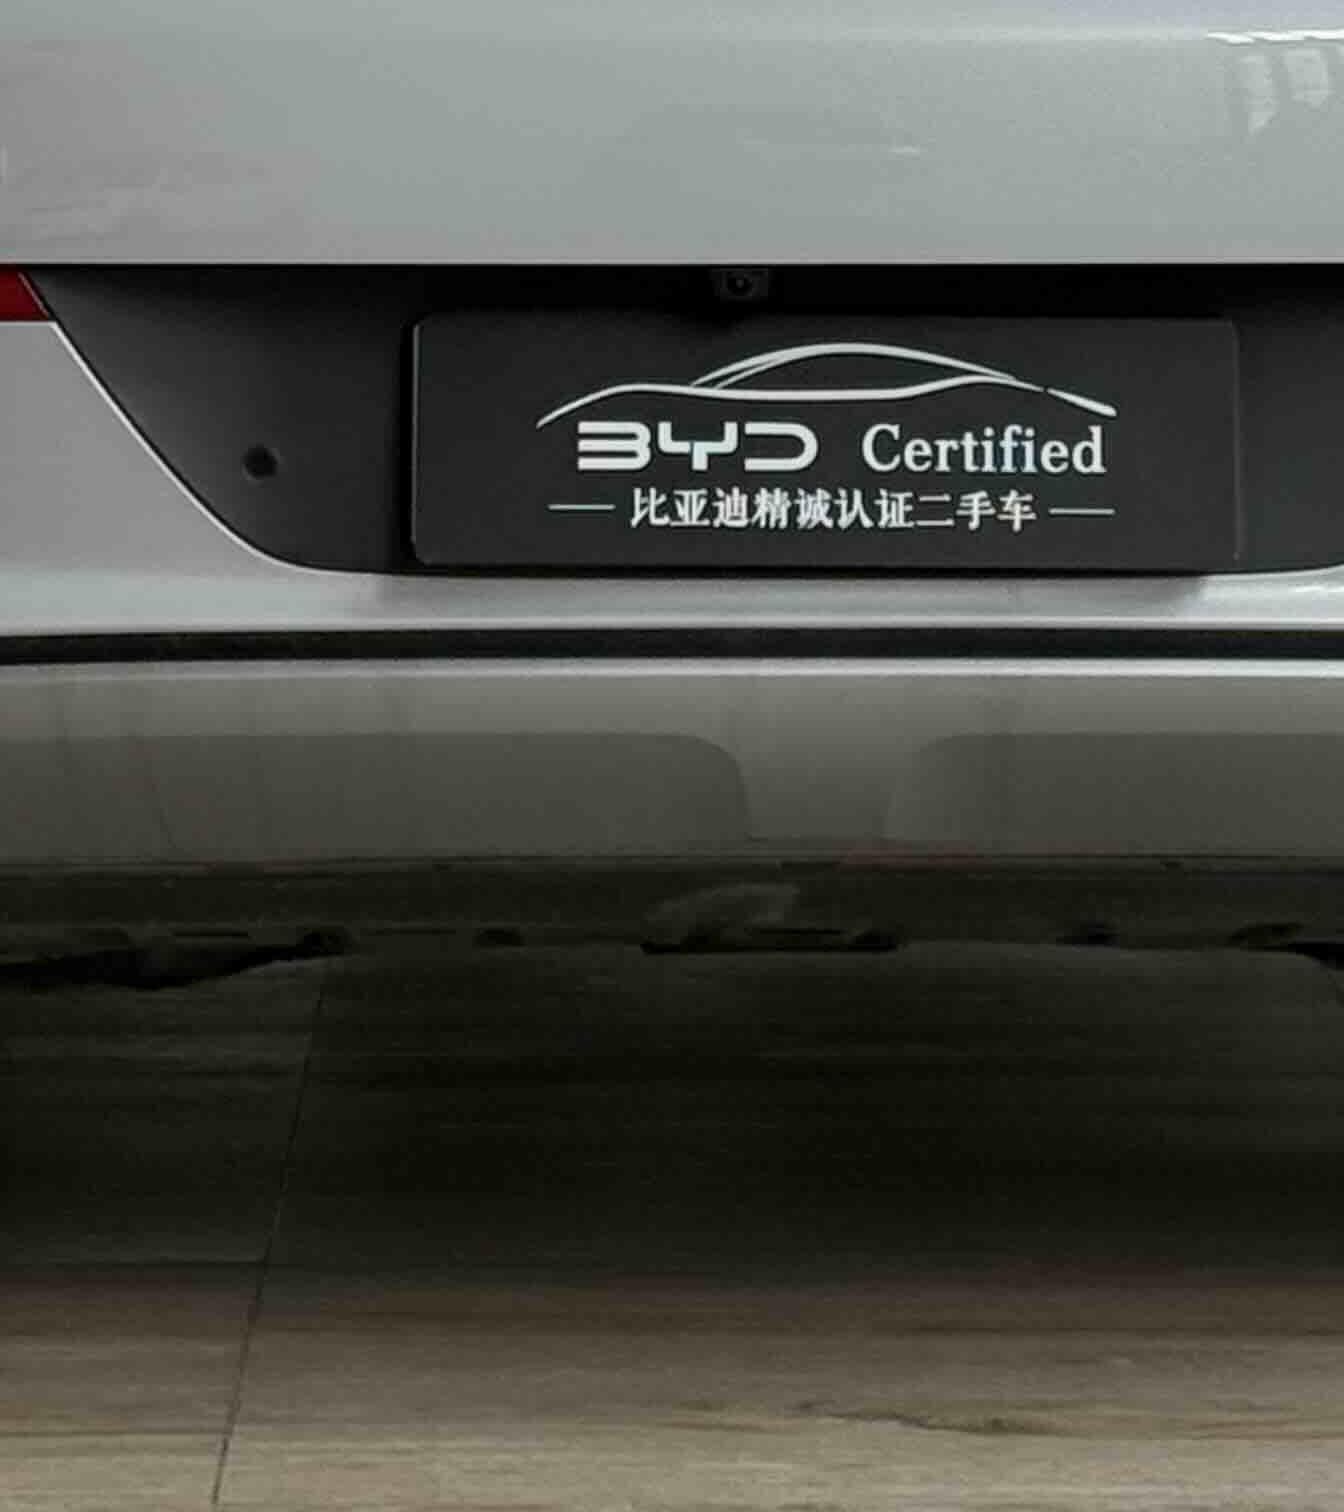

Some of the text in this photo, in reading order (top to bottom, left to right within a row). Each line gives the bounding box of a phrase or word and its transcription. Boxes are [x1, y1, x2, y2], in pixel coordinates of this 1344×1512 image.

[577, 420, 1107, 474] BYD Certified
[629, 486, 1037, 532] 比亚迪精诚认证二手车
